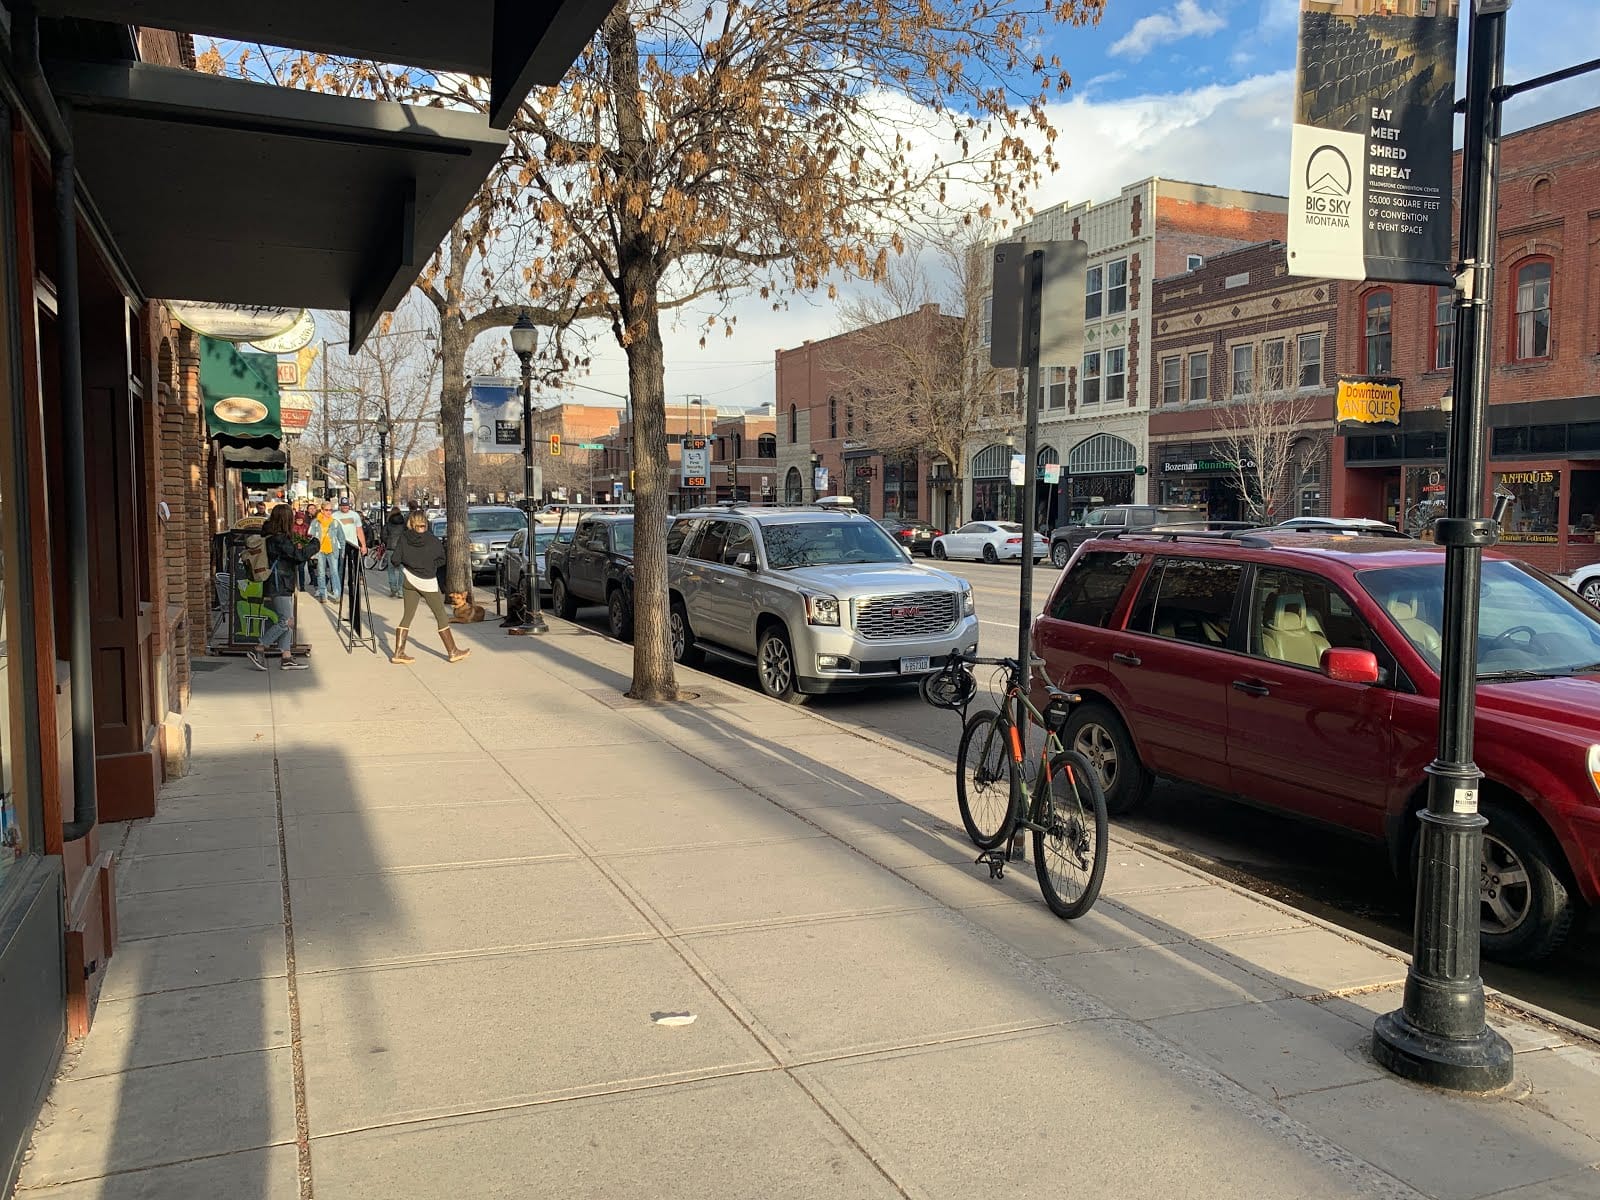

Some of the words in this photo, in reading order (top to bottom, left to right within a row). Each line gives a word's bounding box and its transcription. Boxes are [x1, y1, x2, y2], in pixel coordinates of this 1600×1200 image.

[1371, 107, 1393, 121] EAT
[1370, 125, 1401, 141] MEET
[1369, 144, 1407, 160] SHRED
[1369, 163, 1412, 180] REPEAT
[1368, 180, 1397, 189] YELLOWSTONE
[1396, 183, 1423, 192] CONVENTION
[1306, 196, 1326, 211] BIG
[1328, 198, 1351, 214] SKY
[1368, 195, 1391, 206] 55,000
[1392, 198, 1421, 209] SQUARE
[1423, 201, 1441, 211] FEET
[1305, 215, 1350, 228] MONTANA
[1368, 208, 1379, 217] OF
[1380, 210, 1429, 223] CONVENTION
[1368, 221, 1375, 230] &
[1377, 222, 1399, 232] EVENT
[1400, 224, 1423, 234] SPACE
[1346, 385, 1393, 400] Downtown
[1343, 399, 1396, 418] ANTIQUES
[1165, 462, 1198, 472] Bozeman
[1501, 472, 1554, 484] ANTIQUES
[891, 606, 928, 617] GMC
